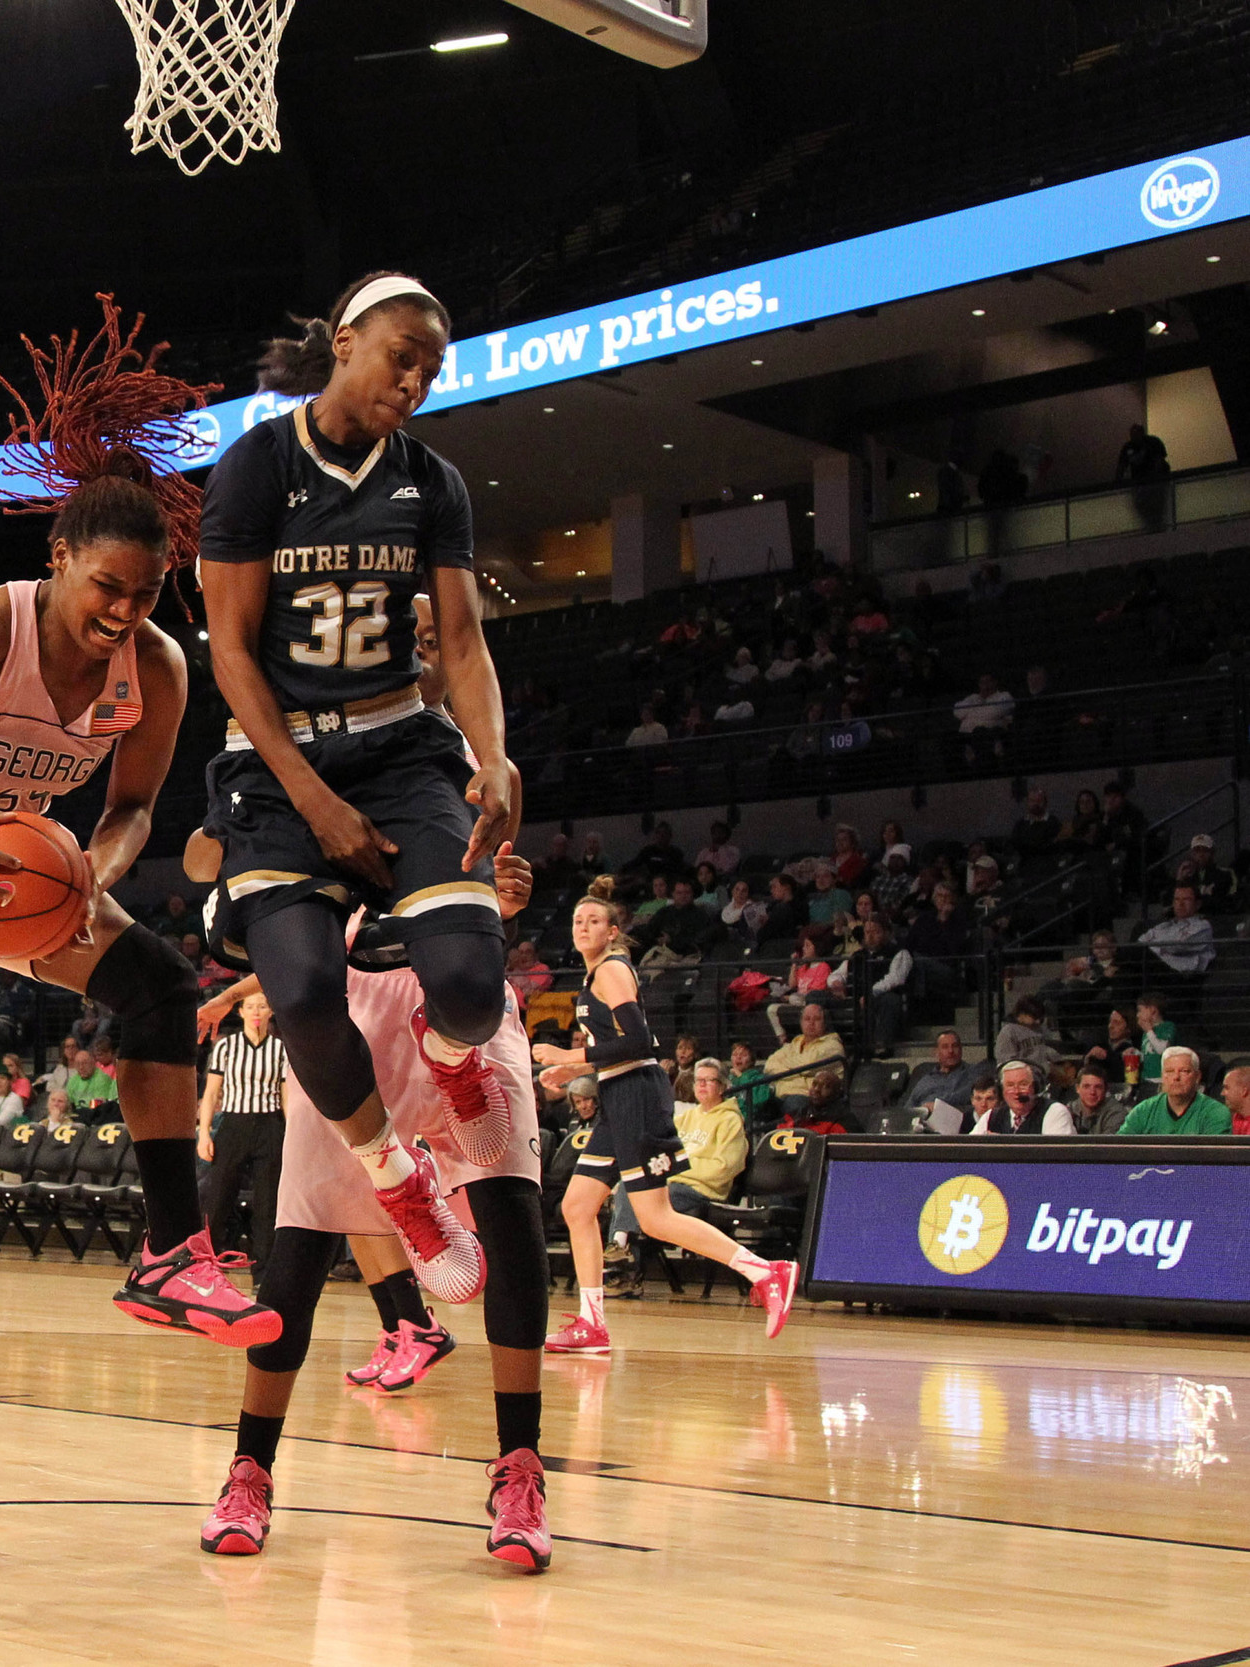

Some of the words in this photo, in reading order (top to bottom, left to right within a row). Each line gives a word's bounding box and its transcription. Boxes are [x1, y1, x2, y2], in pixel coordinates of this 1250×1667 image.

[486, 324, 590, 381] Low
[599, 280, 779, 367] prices.
[358, 544, 417, 573] DAME
[290, 581, 391, 671] 32
[830, 734, 853, 748] 109
[770, 1130, 804, 1154] GT
[1026, 1203, 1193, 1270] bitpay
